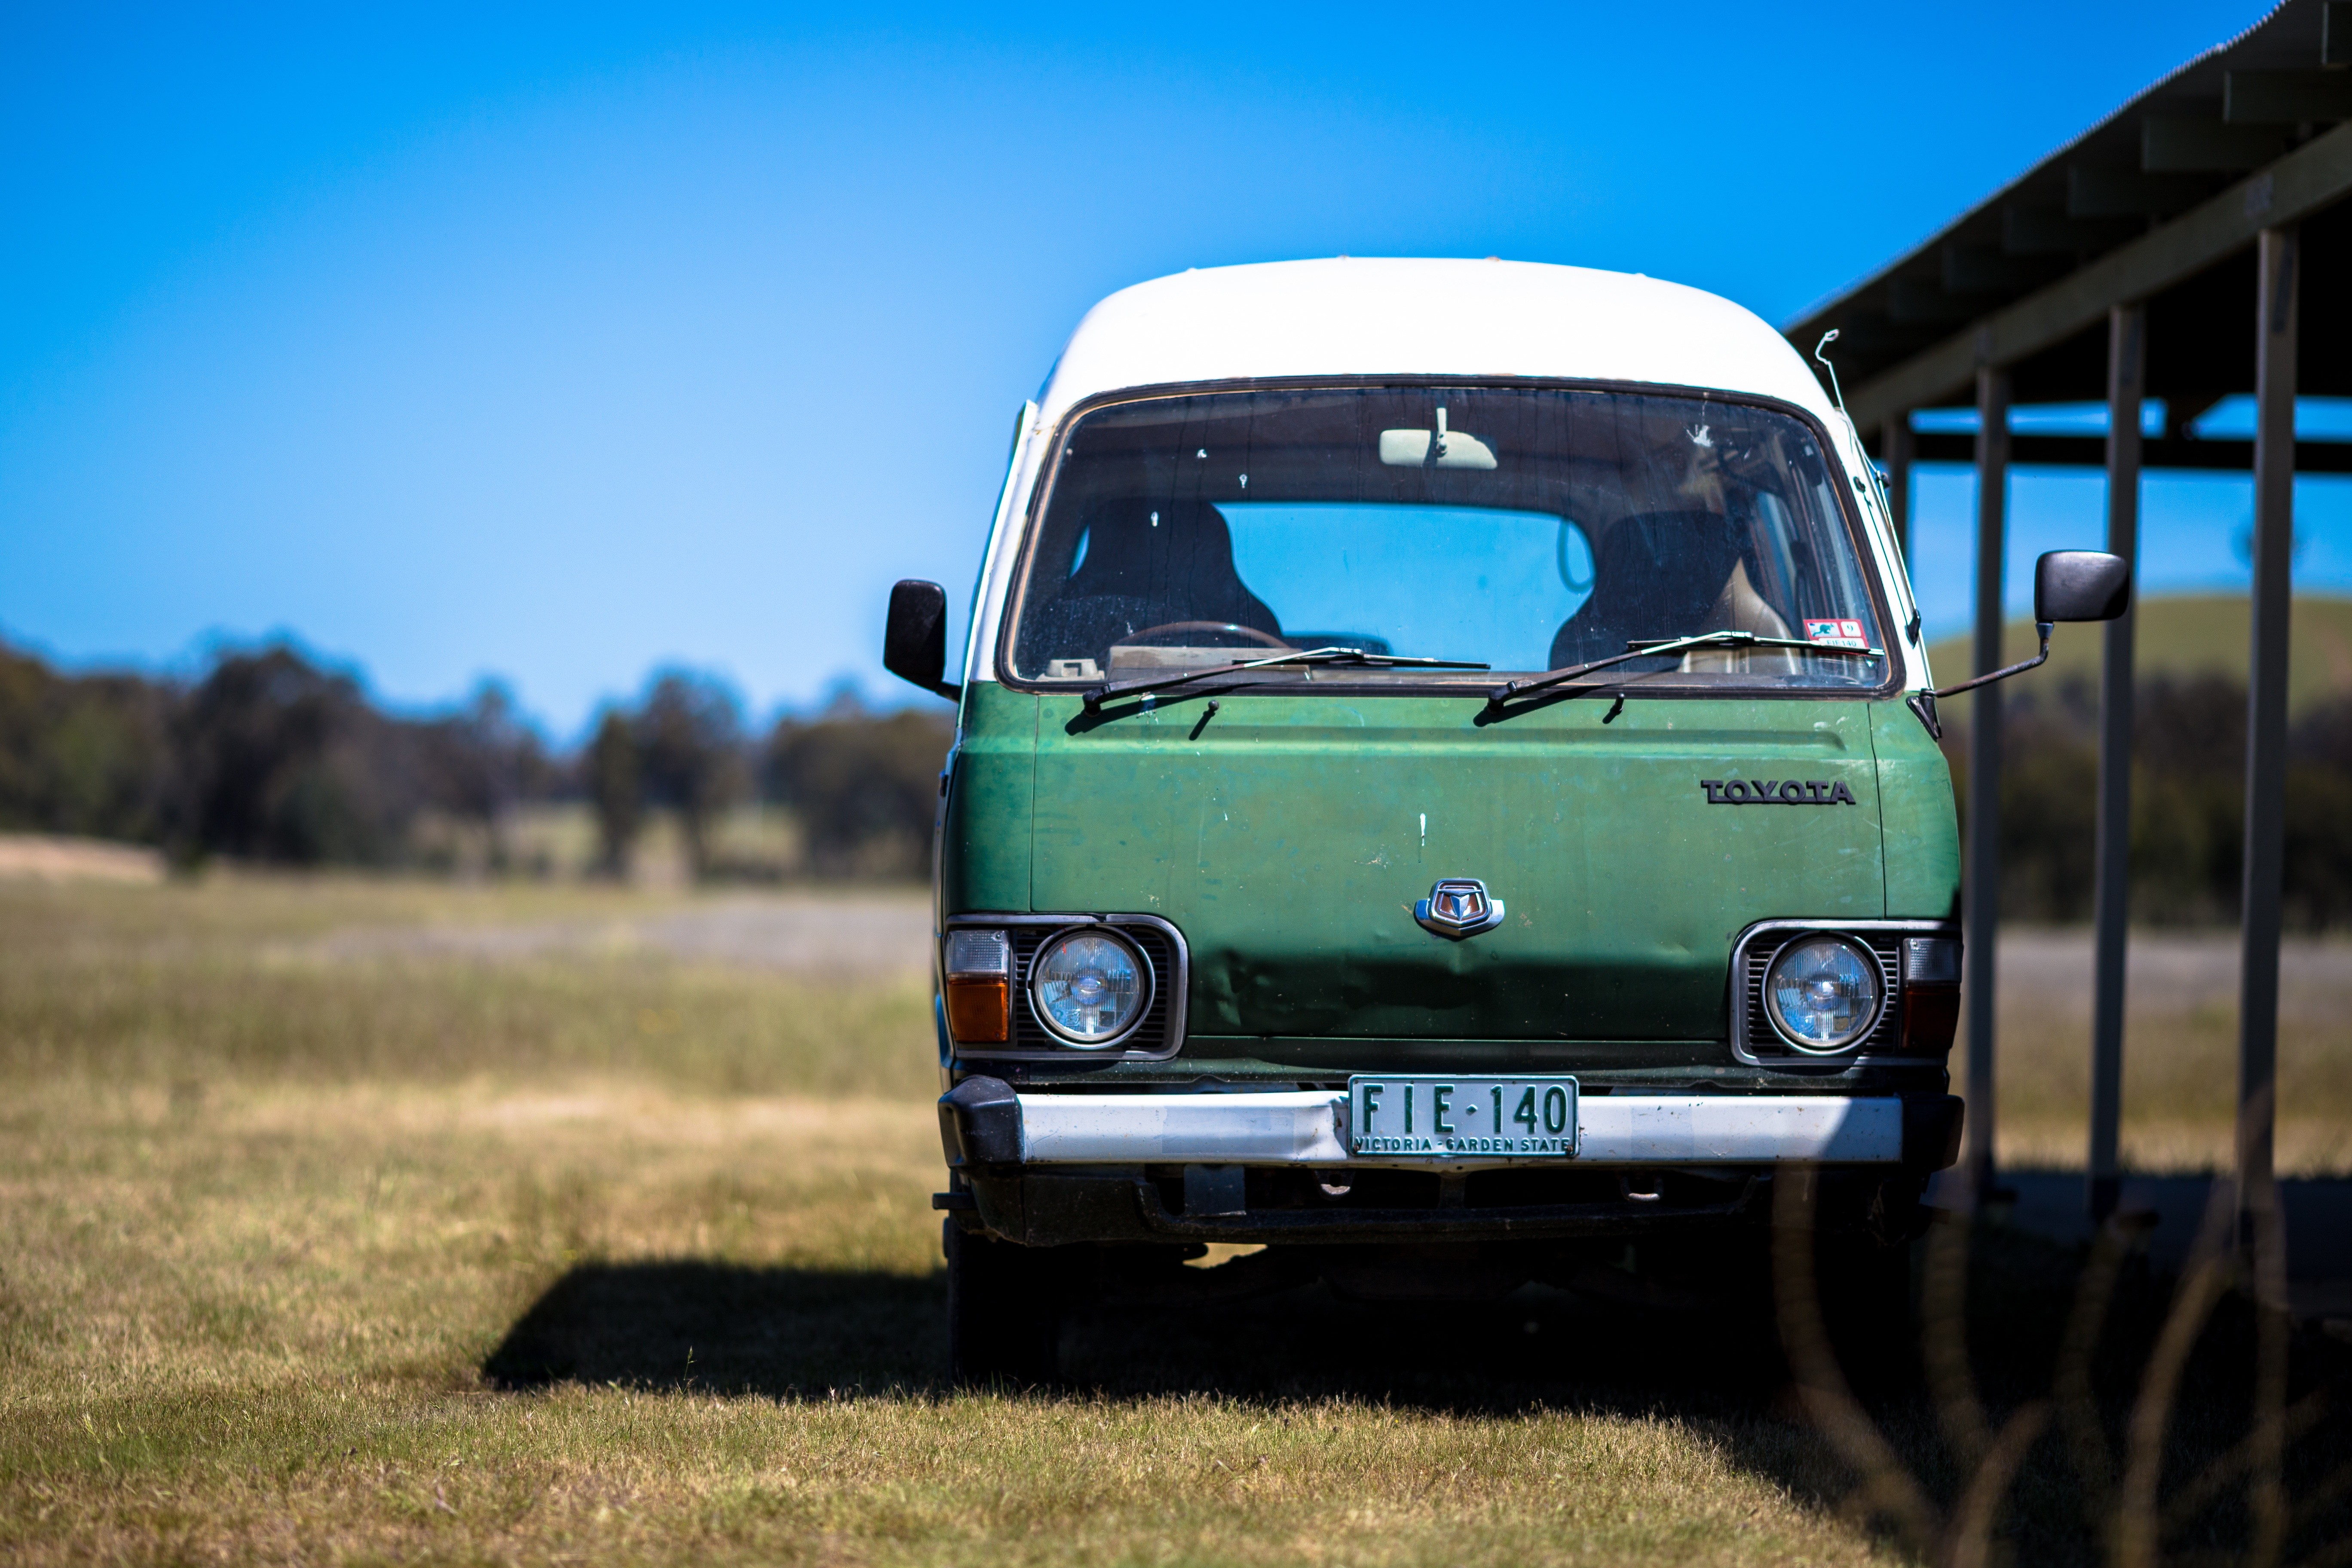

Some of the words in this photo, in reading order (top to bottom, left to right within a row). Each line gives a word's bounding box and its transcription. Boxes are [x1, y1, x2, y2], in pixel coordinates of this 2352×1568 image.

[1701, 779, 1856, 805] TOYOTA
[1355, 1136, 1433, 1152] VICTORIA
[1446, 1137, 1514, 1152] GARDEN
[1521, 1137, 1570, 1152] STATE
